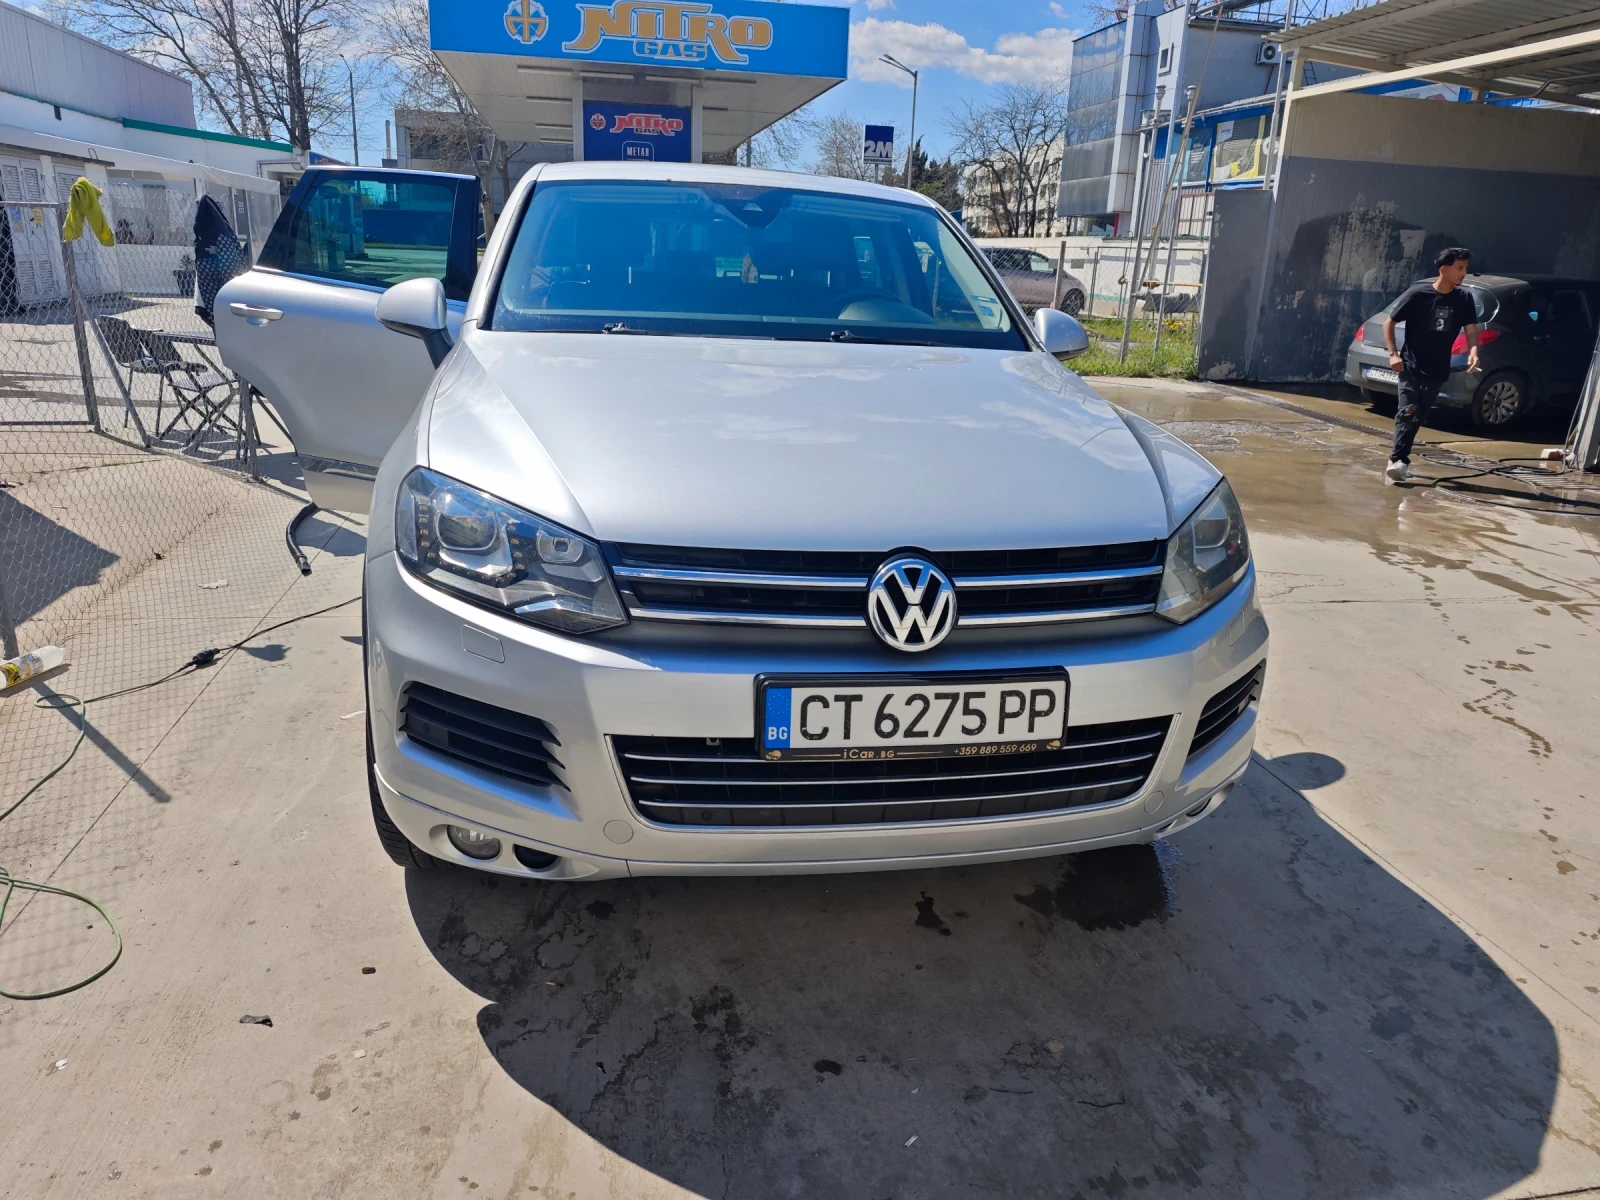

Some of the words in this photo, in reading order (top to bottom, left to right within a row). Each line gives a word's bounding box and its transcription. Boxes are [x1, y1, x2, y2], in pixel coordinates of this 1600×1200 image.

[634, 41, 709, 60] GAS
[864, 140, 893, 158] 2M
[868, 558, 957, 652] VW
[800, 694, 863, 740] CT
[874, 691, 987, 739] 6275
[998, 688, 1056, 735] PP
[768, 726, 788, 740] BG
[954, 746, 978, 756] +359
[979, 745, 998, 755] 889
[999, 744, 1018, 754] 559
[1019, 743, 1037, 752] 669
